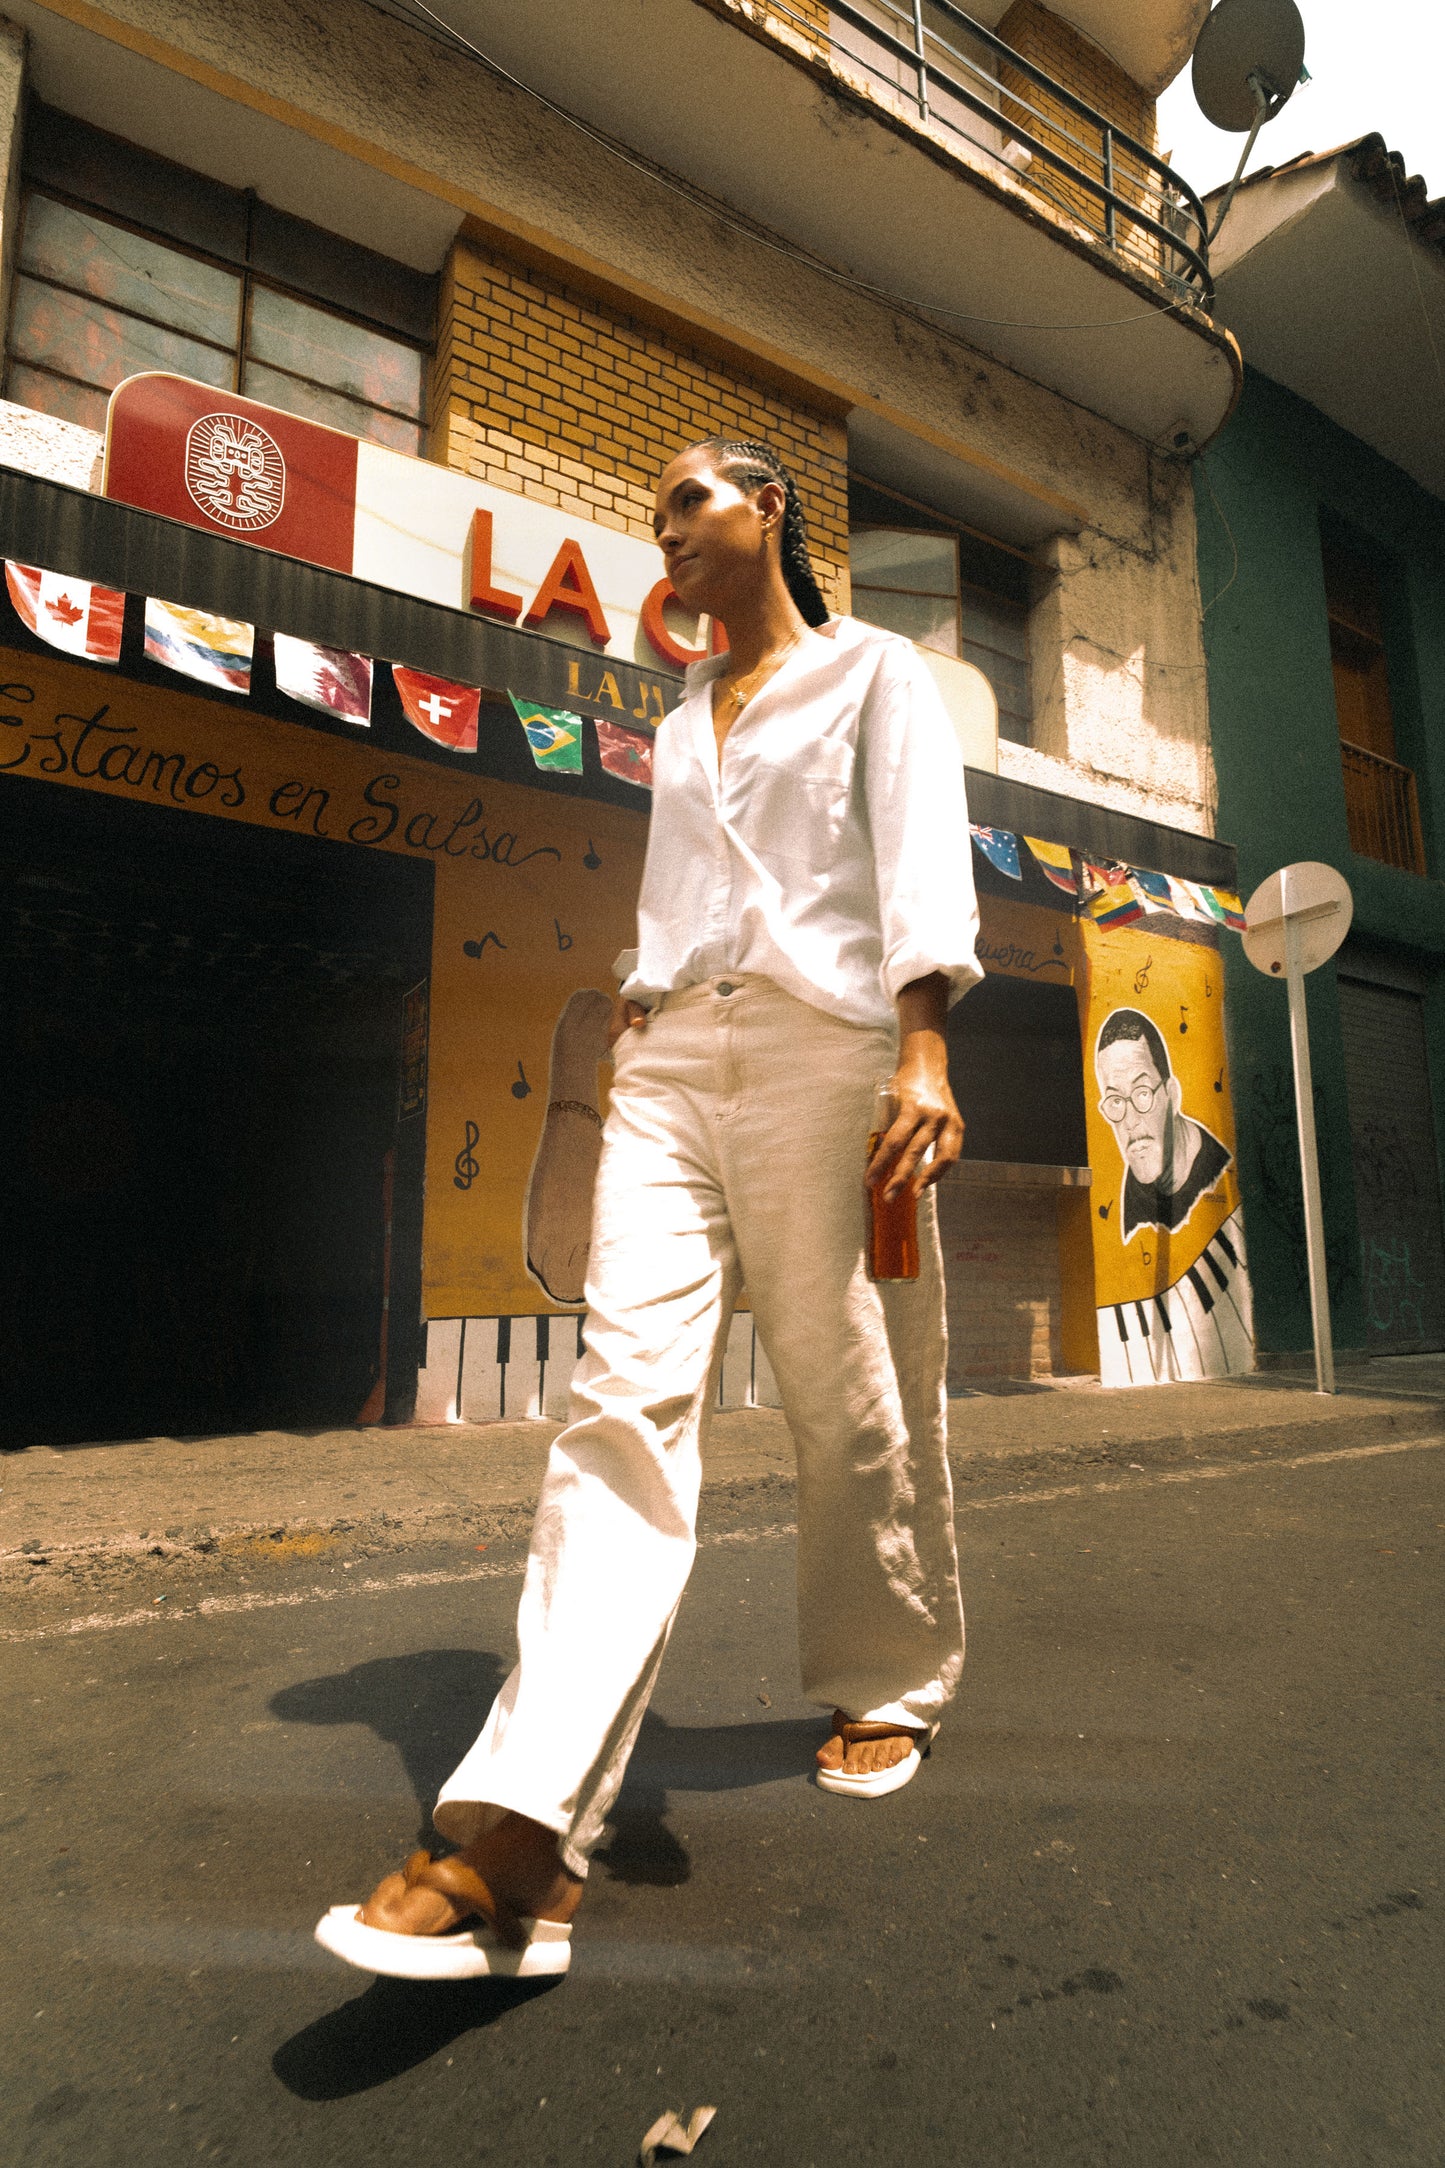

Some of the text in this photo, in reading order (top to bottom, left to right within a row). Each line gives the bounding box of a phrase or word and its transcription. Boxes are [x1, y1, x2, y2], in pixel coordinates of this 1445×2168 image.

[470, 507, 611, 645] LA
[565, 660, 626, 710] LA
[269, 781, 330, 836] en
[348, 774, 561, 866] Salsa
